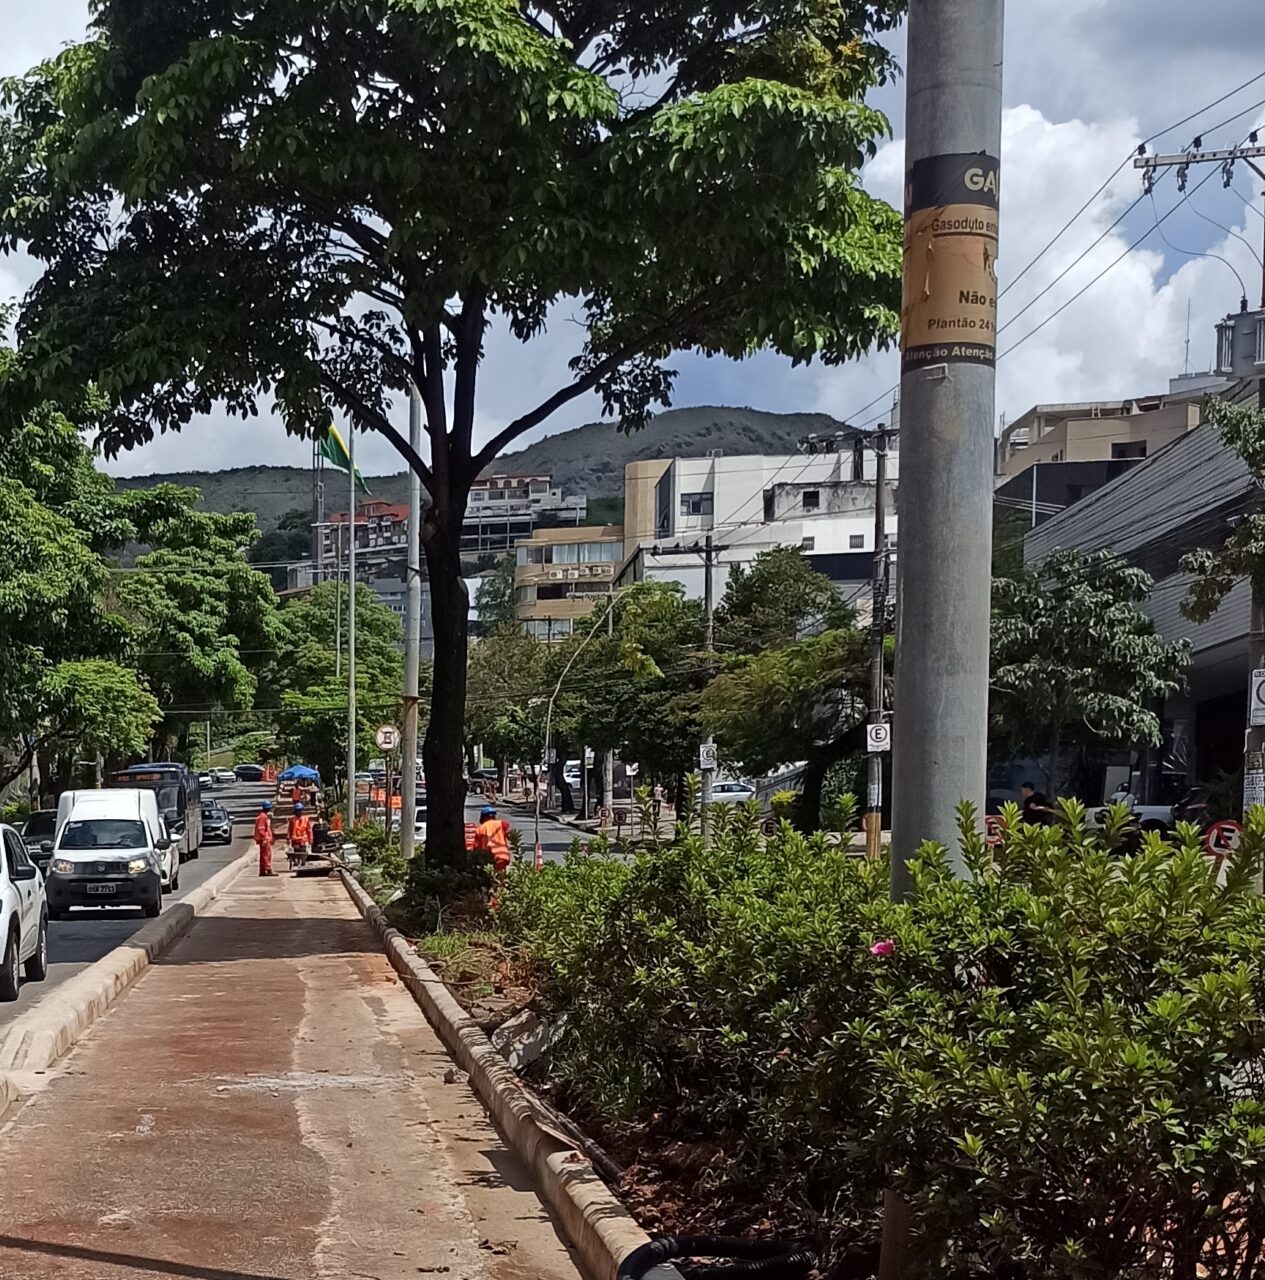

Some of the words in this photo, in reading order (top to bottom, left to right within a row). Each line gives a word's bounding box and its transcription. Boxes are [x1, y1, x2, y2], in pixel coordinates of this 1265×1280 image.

[964, 168, 999, 202] GA
[931, 217, 984, 232] Gasoduto
[958, 290, 986, 306] Não
[989, 298, 996, 308] e
[927, 318, 976, 330] Plantão
[875, 728, 882, 740] E
[1213, 827, 1236, 850] E
